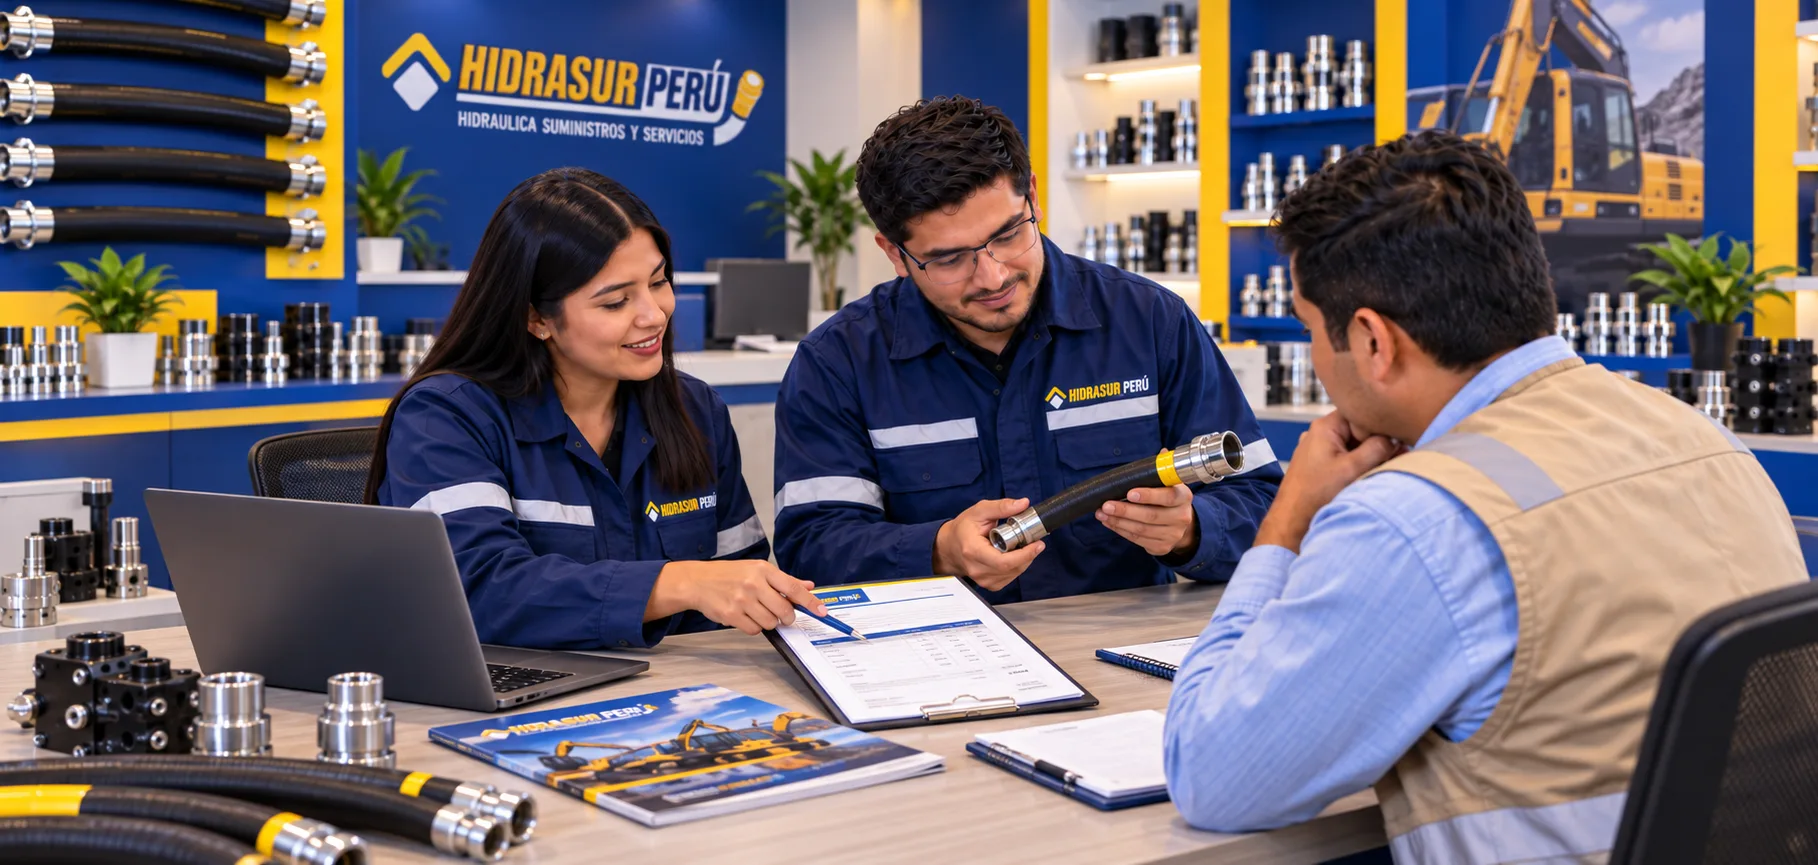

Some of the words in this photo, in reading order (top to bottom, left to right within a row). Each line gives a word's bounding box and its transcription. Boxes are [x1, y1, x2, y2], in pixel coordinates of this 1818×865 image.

[458, 43, 640, 106] HIDRASUR
[645, 58, 726, 114] PERÚ
[457, 110, 537, 133] HIDRAULICA
[542, 117, 626, 140] SUMINISTROS
[630, 125, 639, 141] Y
[643, 126, 705, 146] SERVICIOS
[1068, 381, 1121, 402] HIDRASUR
[1123, 374, 1149, 394] PERÚ
